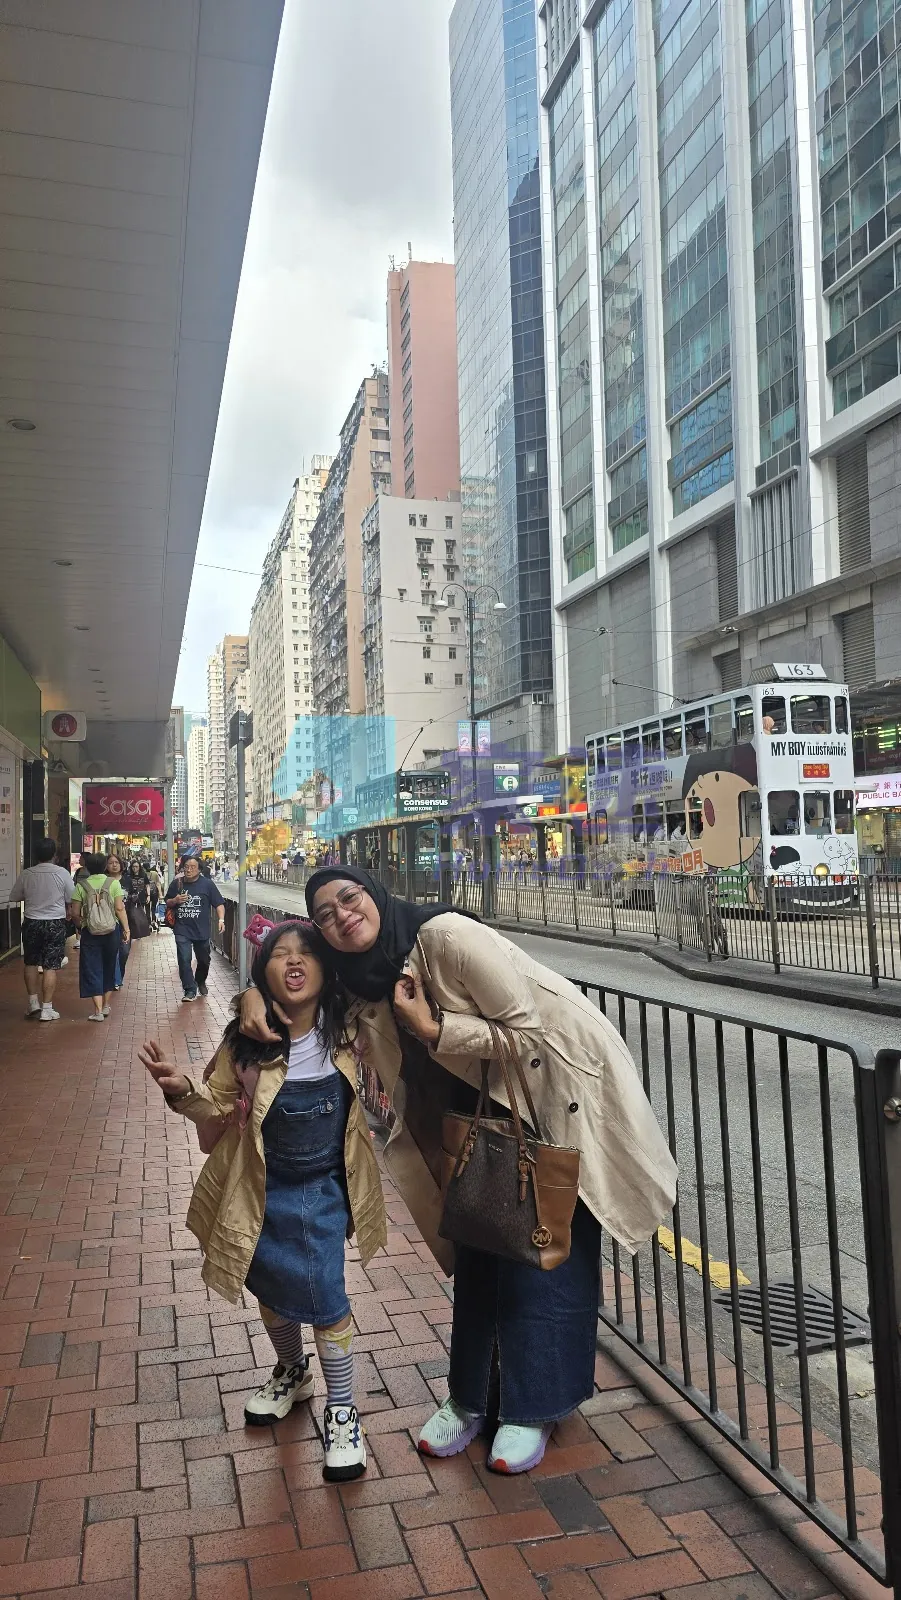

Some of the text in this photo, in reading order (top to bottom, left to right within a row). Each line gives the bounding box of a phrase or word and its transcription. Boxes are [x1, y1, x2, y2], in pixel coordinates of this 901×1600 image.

[787, 664, 814, 676] 163
[762, 687, 775, 696] 163
[771, 741, 847, 757] MY BOY ILLUSTRATIONS
[862, 791, 890, 800] PUBLIC
